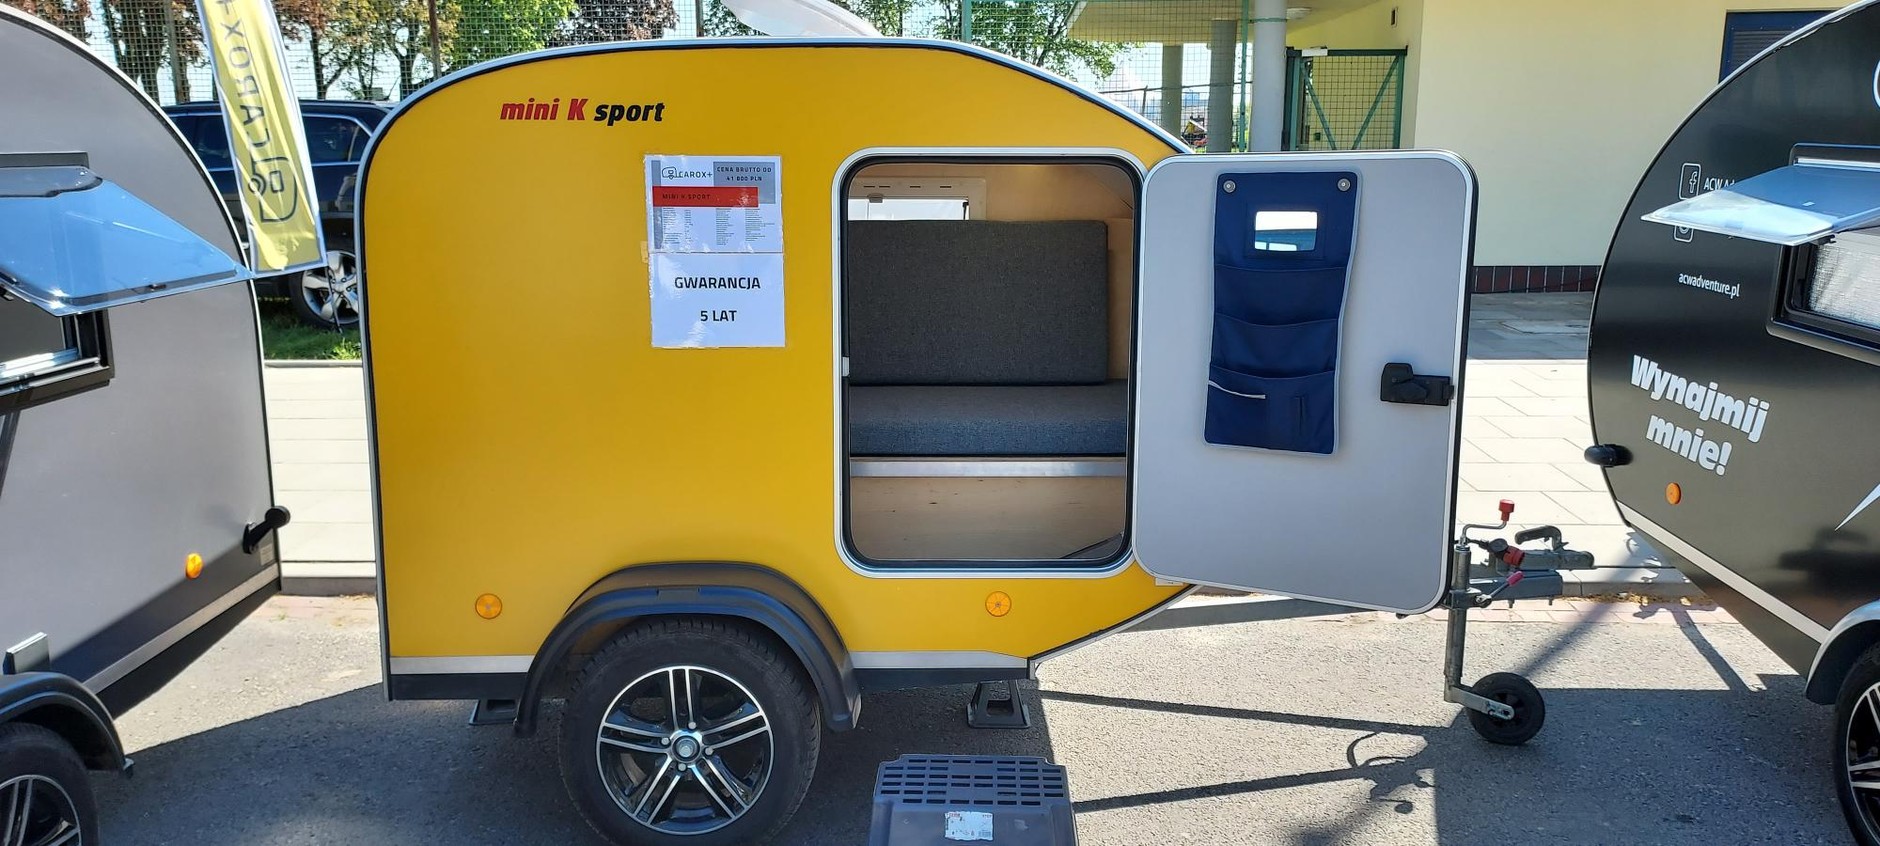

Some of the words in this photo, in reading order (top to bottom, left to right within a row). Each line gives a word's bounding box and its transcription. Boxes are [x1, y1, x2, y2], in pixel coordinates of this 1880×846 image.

[500, 97, 560, 121] mini
[567, 98, 588, 121] K
[593, 102, 665, 127] sport
[1703, 177, 1723, 190] ACW
[674, 276, 761, 290] GWARANCJA
[1678, 272, 1740, 299] acwadventure.pl
[700, 310, 708, 322] 5
[712, 310, 737, 322] LAT
[1631, 354, 1770, 443] Wynajmij
[1646, 414, 1732, 476] mnie!
